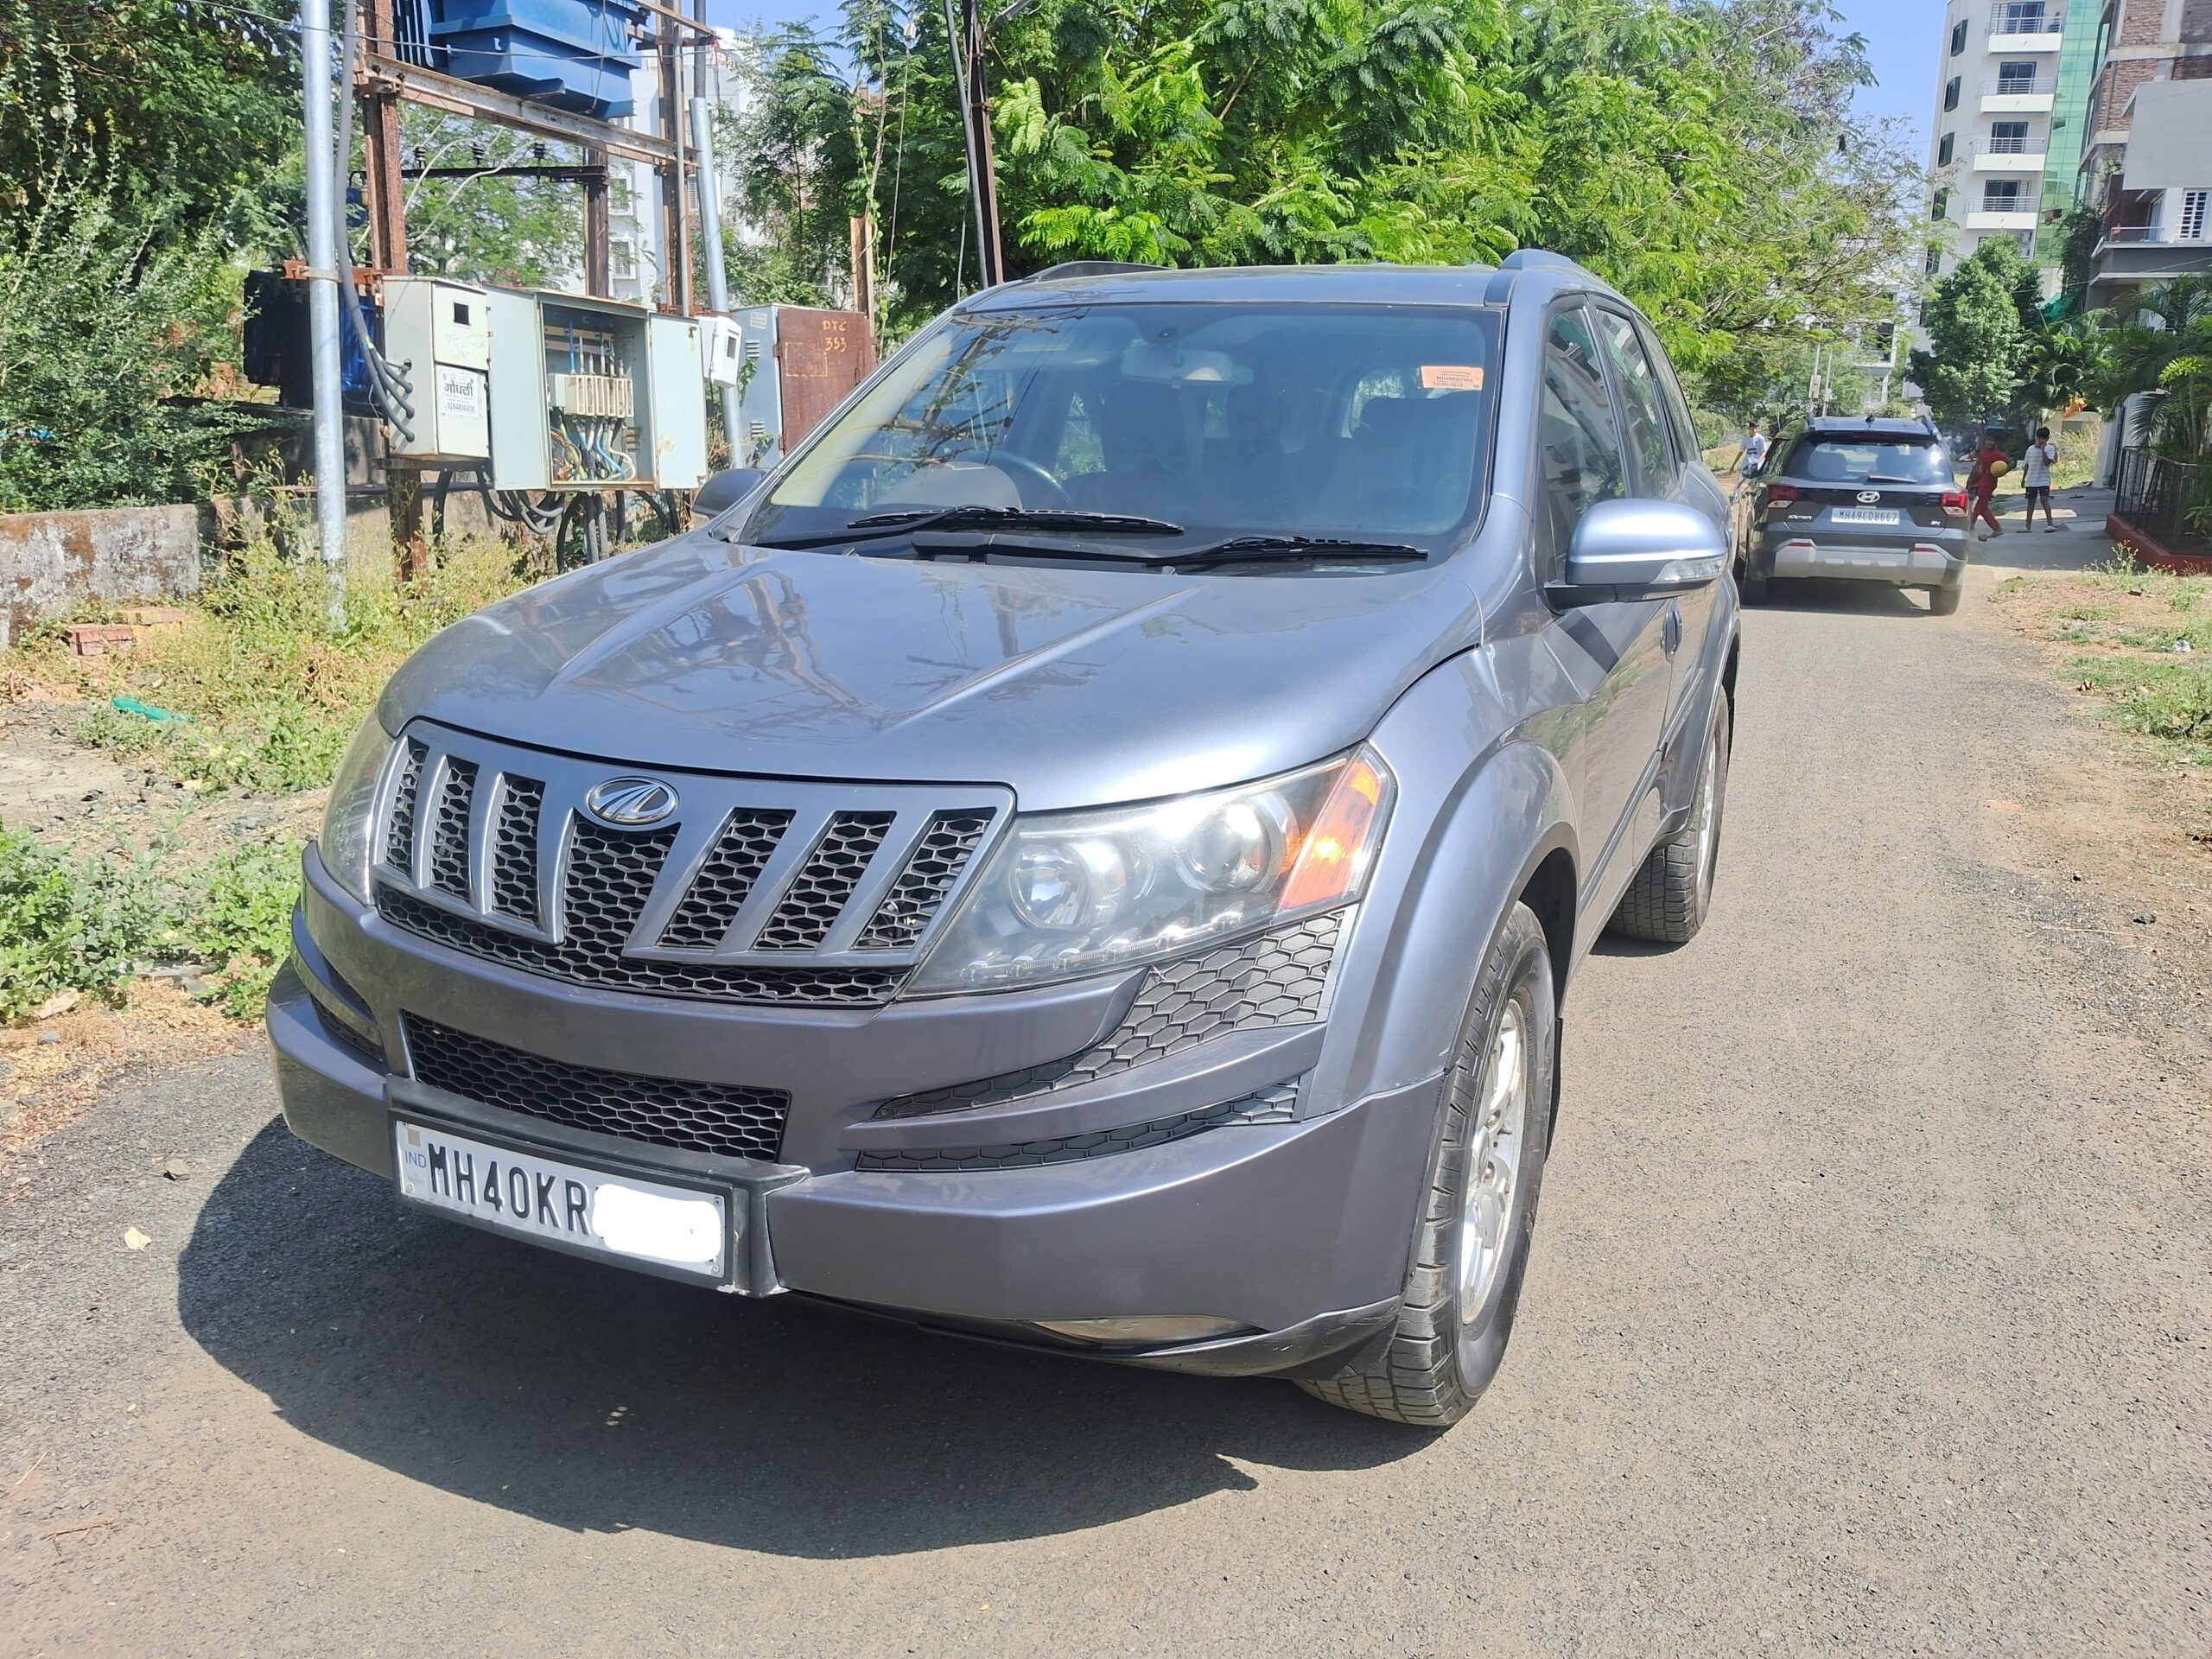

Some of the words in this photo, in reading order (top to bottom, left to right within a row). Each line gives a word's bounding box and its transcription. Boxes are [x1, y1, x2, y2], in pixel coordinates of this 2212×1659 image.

[823, 321, 847, 331] DTC
[824, 337, 847, 353] 353
[1839, 511, 1897, 522] MH49CD8667
[405, 1150, 426, 1168] IND
